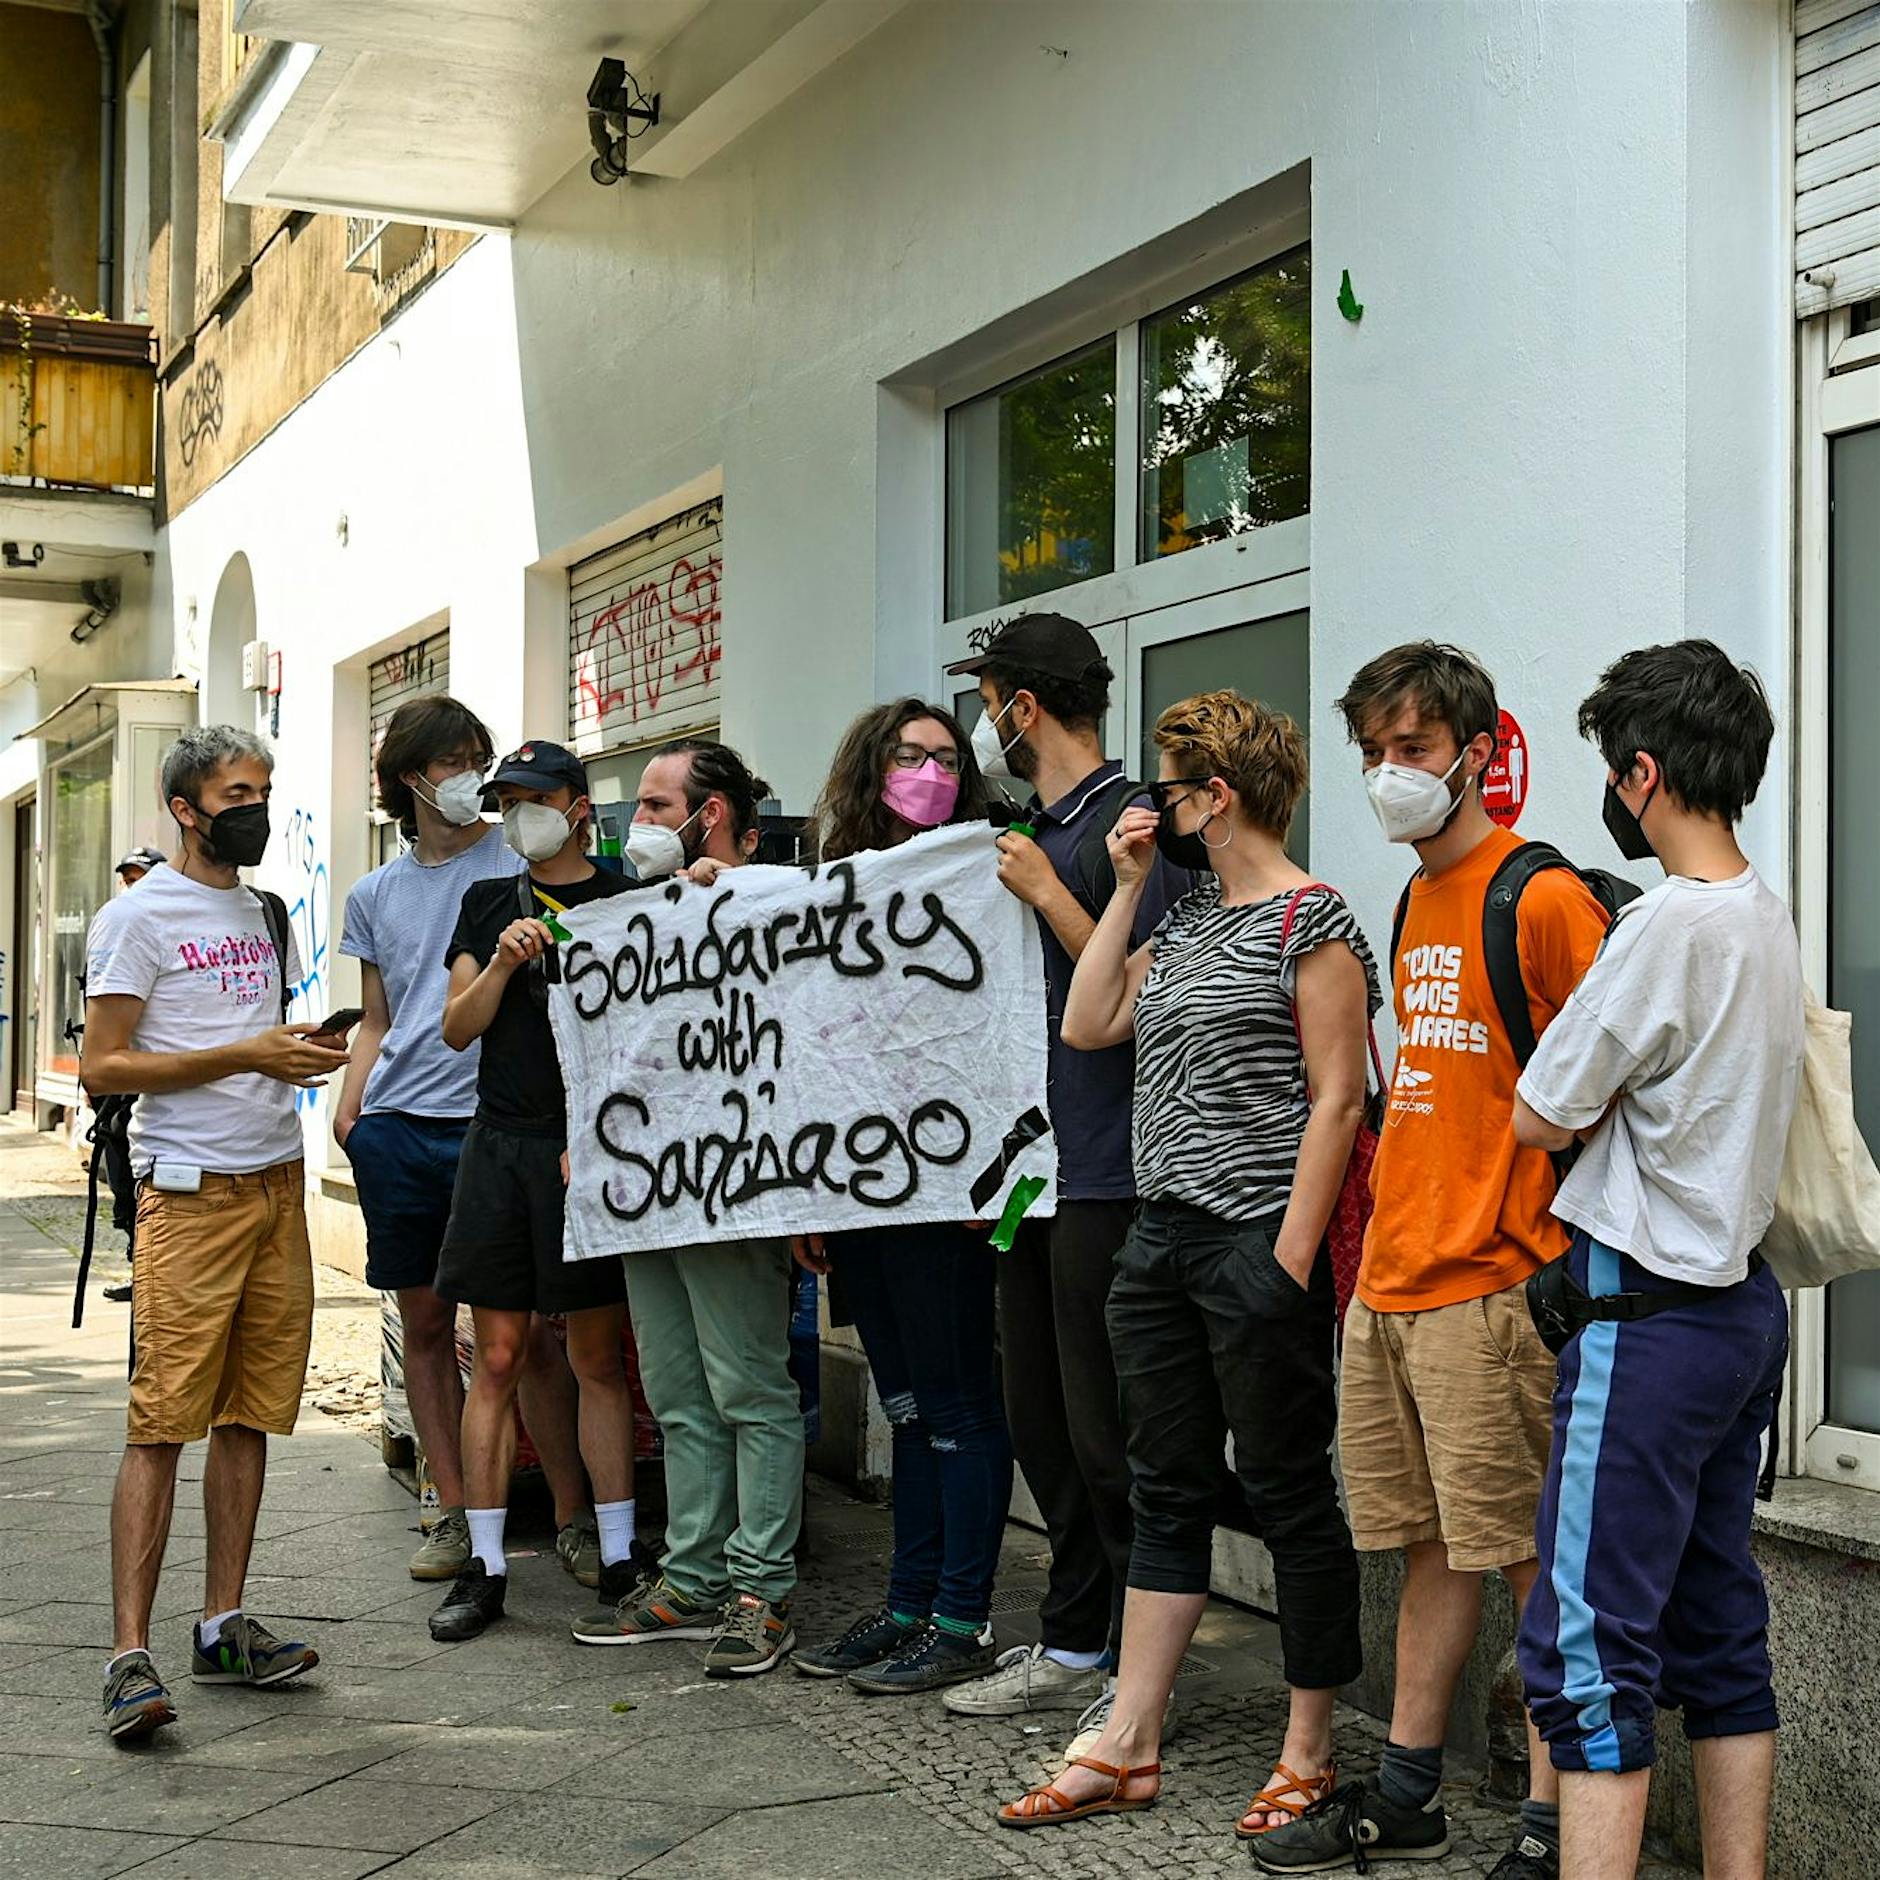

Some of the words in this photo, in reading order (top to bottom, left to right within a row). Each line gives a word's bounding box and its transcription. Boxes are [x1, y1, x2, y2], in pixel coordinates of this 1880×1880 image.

[236, 991, 261, 1006] 2020
[678, 986, 784, 1076] with
[595, 1080, 972, 1226] Santiago
